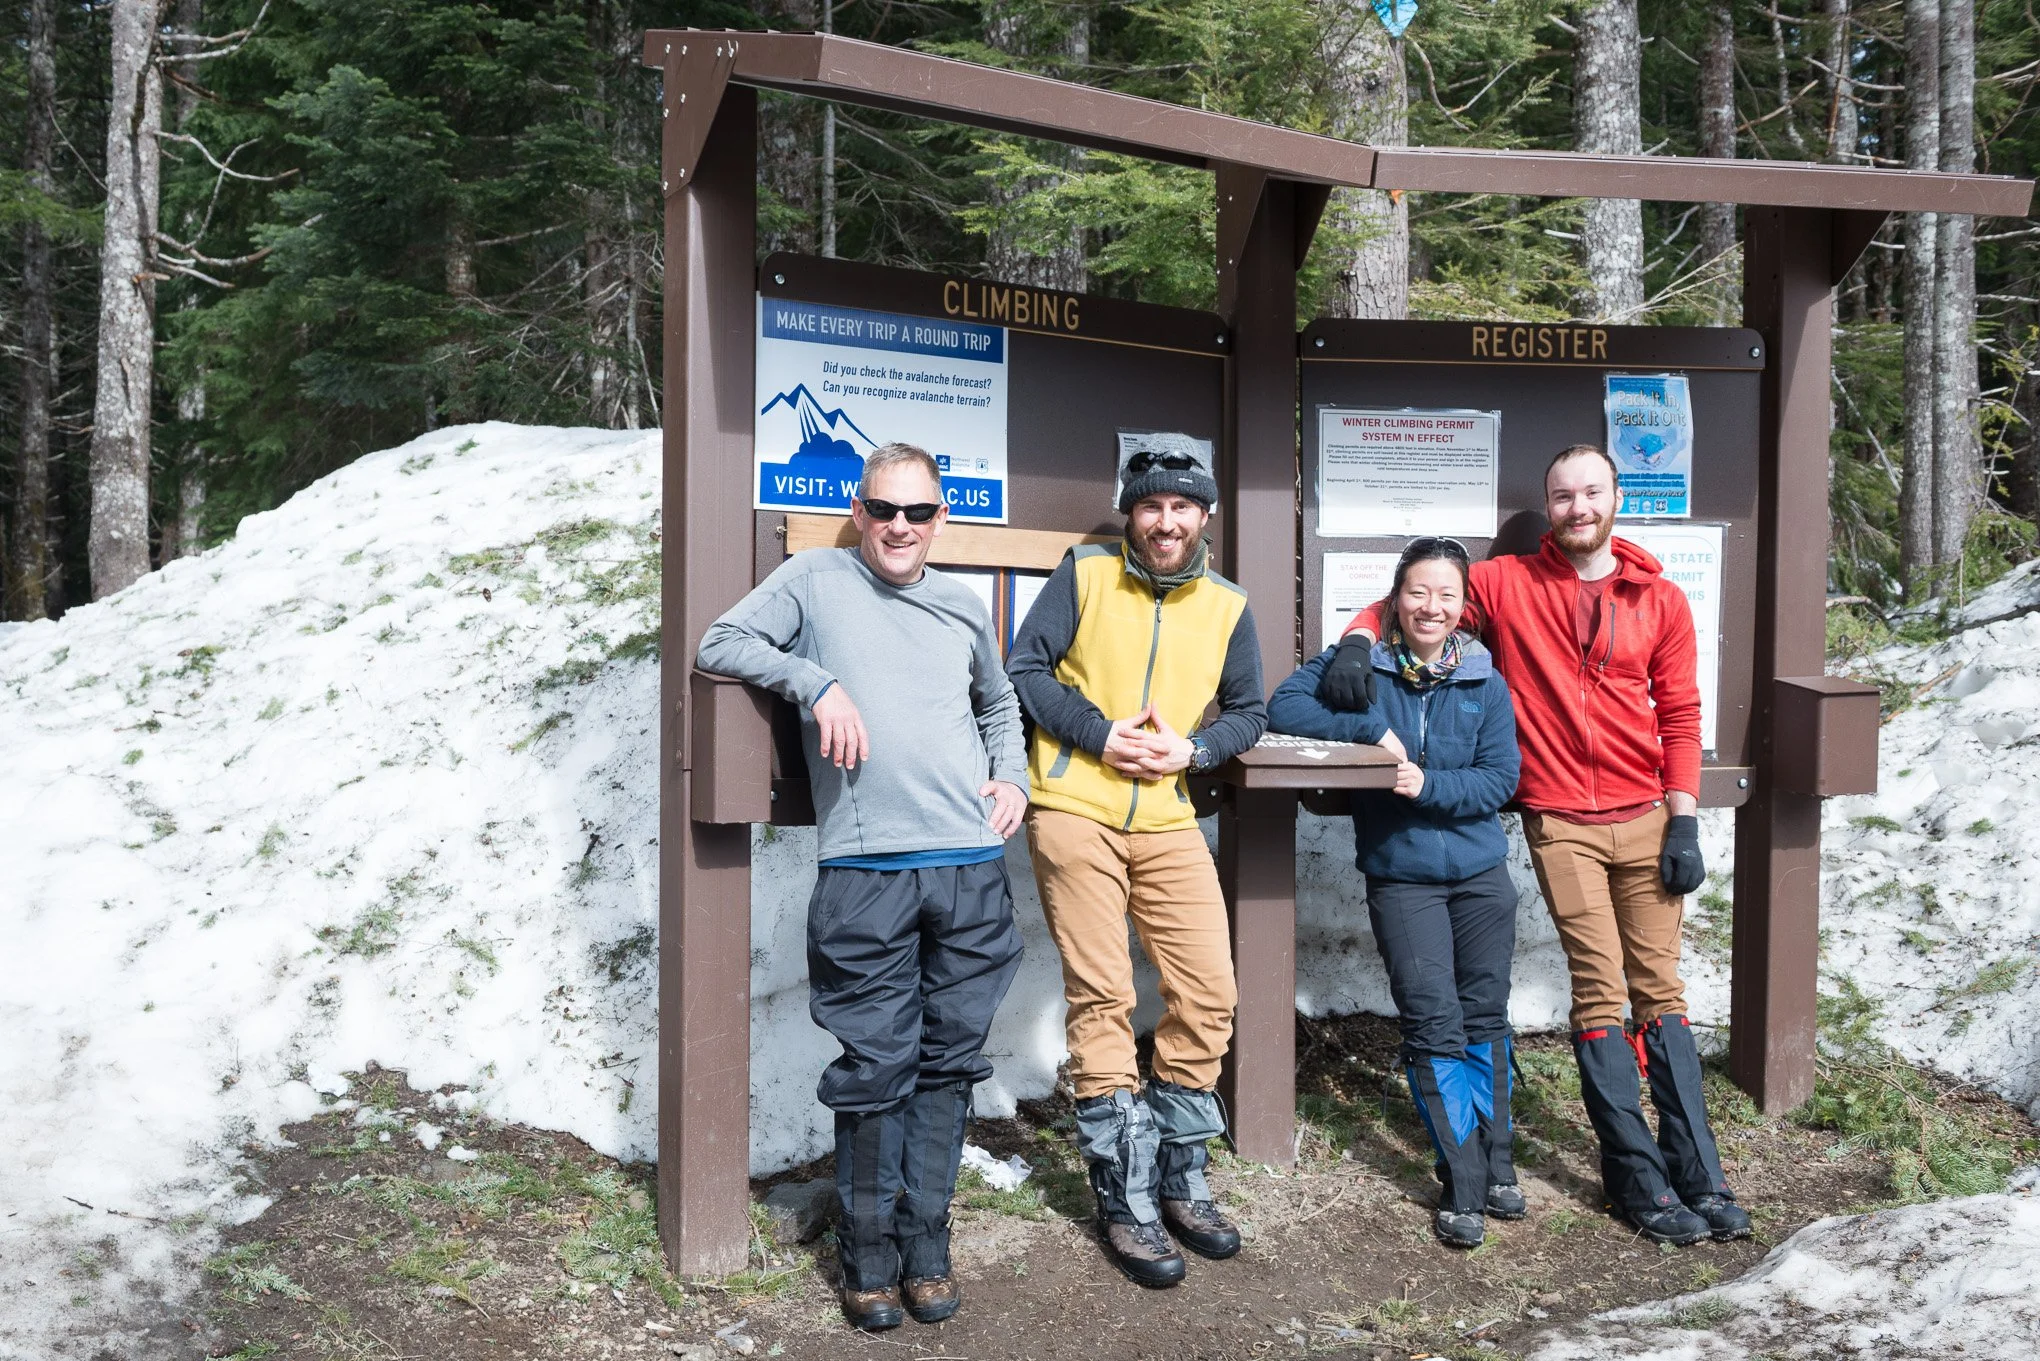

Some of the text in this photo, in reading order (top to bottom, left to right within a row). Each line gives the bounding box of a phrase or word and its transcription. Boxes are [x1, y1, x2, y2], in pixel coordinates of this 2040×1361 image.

[944, 280, 1080, 330] CLIMBING
[777, 311, 991, 352] MAKE EVERY TRIP A ROUND TRIP
[1472, 326, 1608, 359] REGISTER
[823, 361, 992, 390] Did you check the avalanche forecast?
[823, 380, 992, 408] Can you recognize avalanche terrain?
[1617, 390, 1648, 406] Pack
[1651, 390, 1661, 406] It
[1342, 418, 1475, 430] WINTER CLIMBING PERMIT
[1614, 409, 1687, 426] Pack It Out
[1362, 432, 1454, 443] SYSTEM IN EFFECT
[775, 475, 834, 496] VISIT:
[1670, 553, 1713, 564] STATE
[1664, 572, 1705, 582] ERMIT
[1688, 590, 1705, 600] HIS
